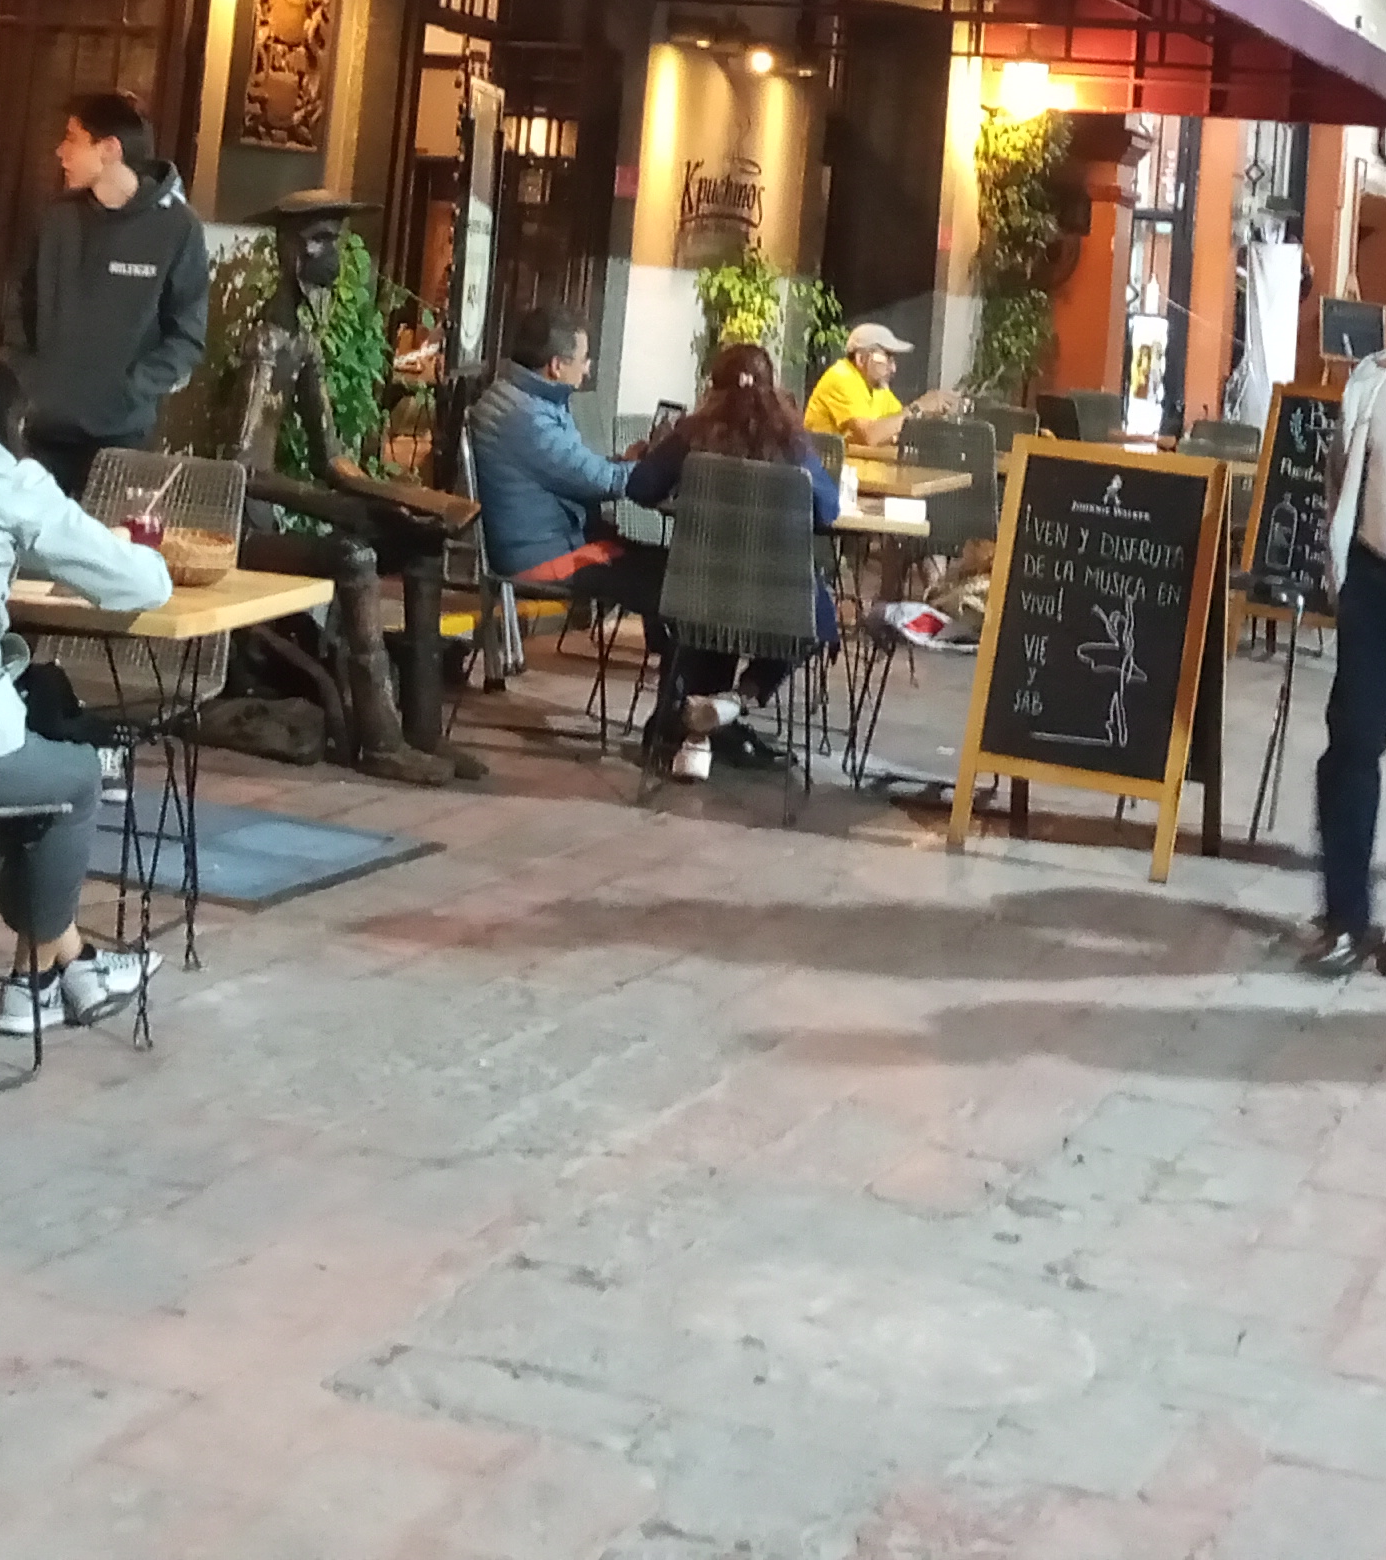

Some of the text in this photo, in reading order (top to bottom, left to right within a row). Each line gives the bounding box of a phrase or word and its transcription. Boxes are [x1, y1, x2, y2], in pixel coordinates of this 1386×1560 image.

[1100, 531, 1185, 570] DISFRUTA
[1024, 553, 1182, 607] DE LA MUSICA EN
[1021, 586, 1064, 623] VIVO!
[1024, 633, 1049, 666] VIE
[1014, 689, 1043, 716] SAB
